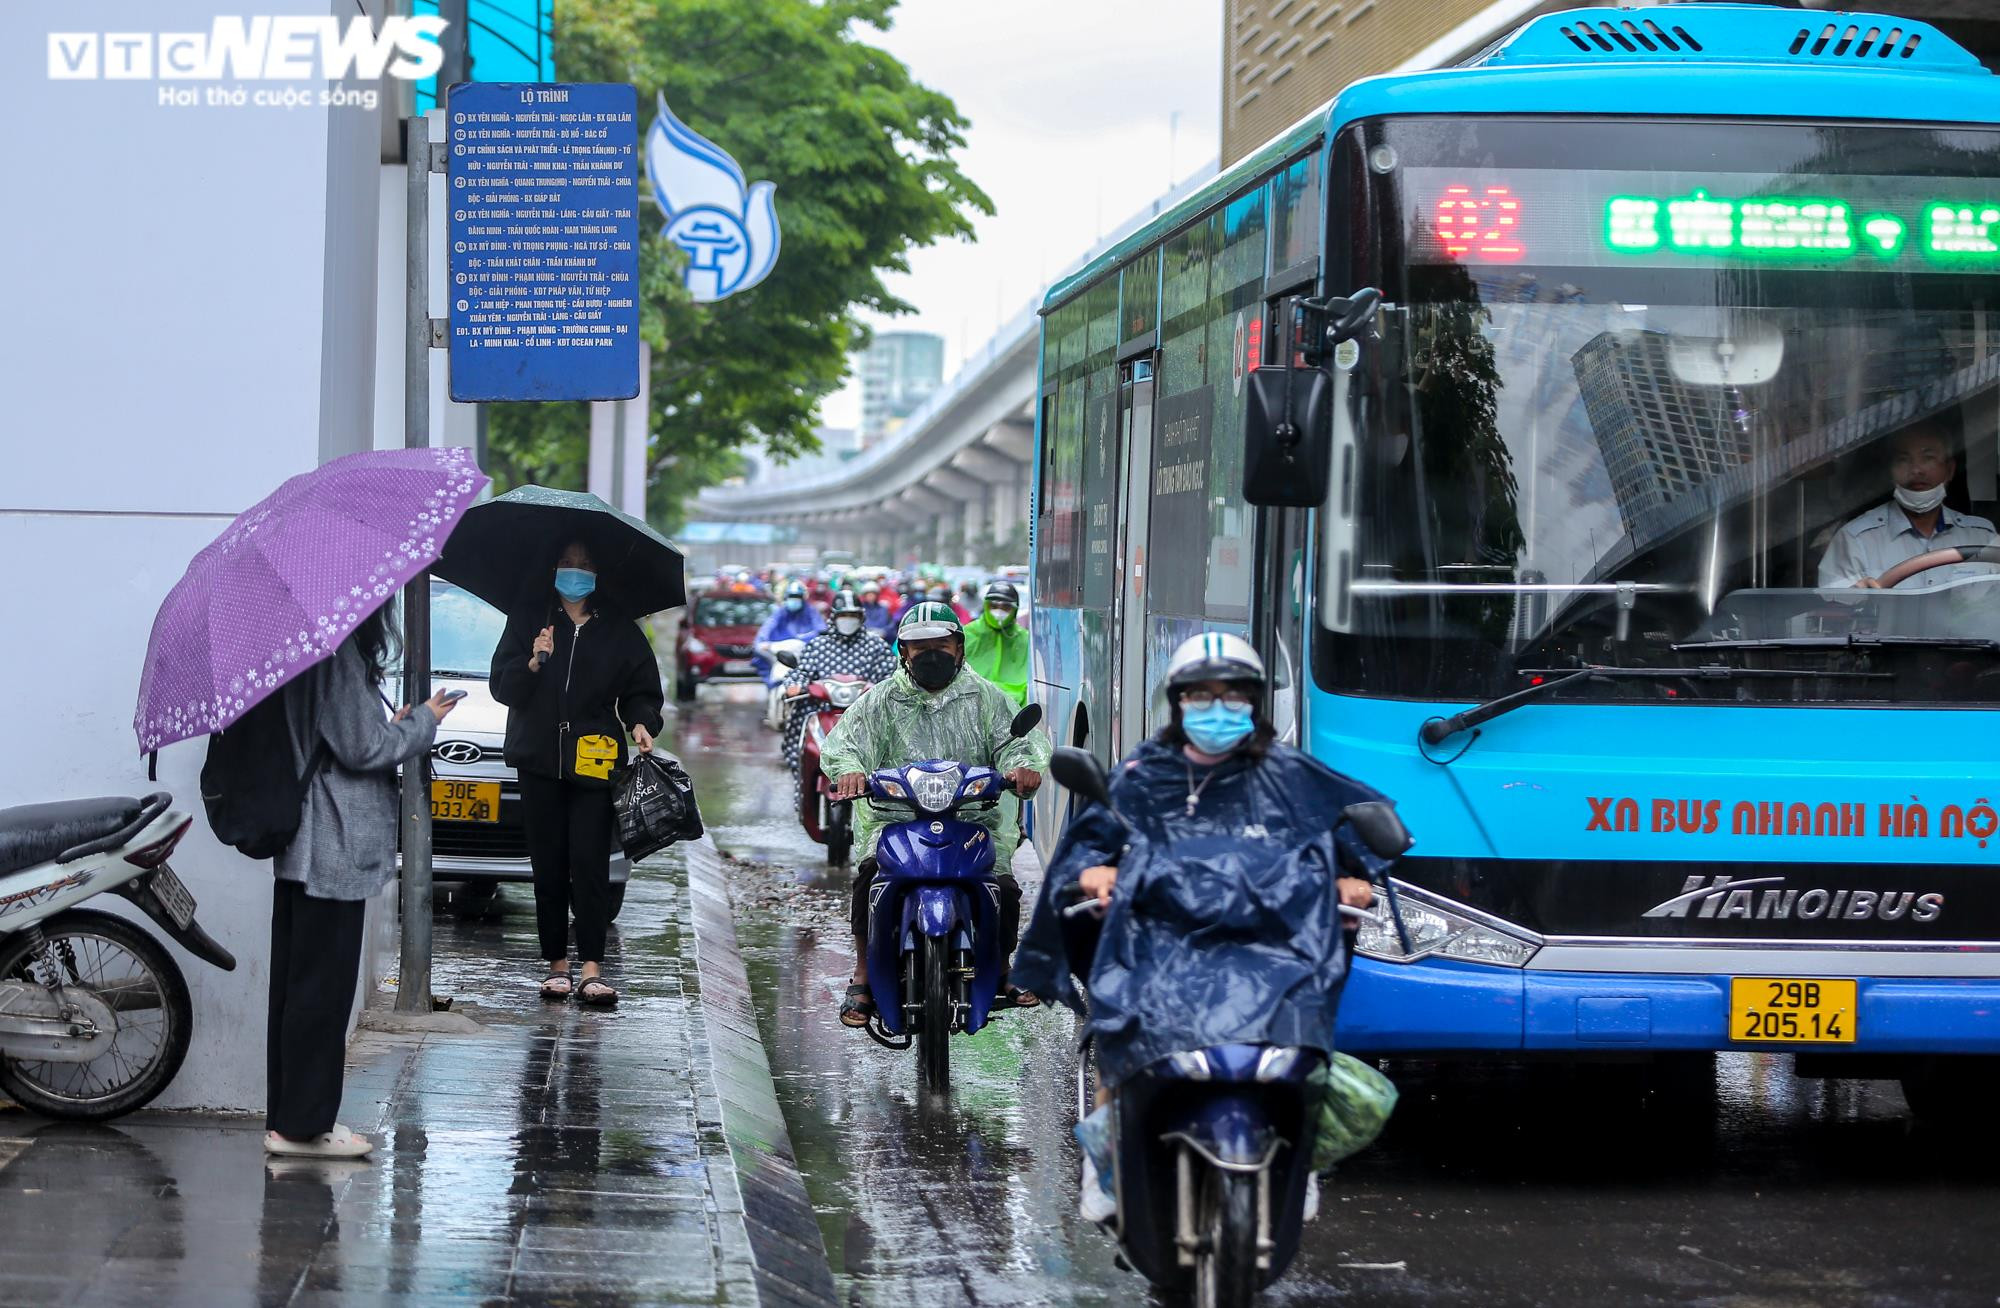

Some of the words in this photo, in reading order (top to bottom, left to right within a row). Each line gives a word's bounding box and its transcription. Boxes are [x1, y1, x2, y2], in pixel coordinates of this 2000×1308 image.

[521, 88, 534, 106] LỘ
[537, 88, 569, 103] TRÌNH
[468, 114, 476, 122] BX
[597, 114, 605, 122] BX
[607, 114, 617, 122] GIA
[468, 130, 477, 139] BX
[468, 146, 476, 154] HV
[534, 162, 551, 170] MINH
[552, 162, 567, 170] KHAI
[468, 178, 476, 187] BX
[514, 178, 535, 187] QUANG
[524, 194, 533, 203] BX
[468, 210, 476, 219] BX
[1437, 188, 1520, 253] 02
[486, 227, 502, 235] NINH
[564, 226, 579, 234] NAM
[601, 226, 618, 234] LONG
[468, 242, 478, 251] BX
[468, 273, 478, 282] BX
[481, 301, 494, 309] TAM
[515, 300, 533, 308] PHAN
[472, 327, 482, 335] BX
[484, 339, 502, 347] MINH
[503, 338, 520, 347] KHAI
[536, 338, 552, 347] LINH
[571, 338, 594, 347] OCEAN
[595, 338, 613, 347] PARK
[444, 782, 478, 800] 30E
[1586, 797, 1640, 832] XN
[1651, 798, 1721, 834] BUS
[1732, 801, 1866, 837] NHANH
[1878, 795, 1928, 838] HÀ
[1641, 875, 1945, 923] HANOIBUS
[1767, 982, 1821, 1009] 29B
[1744, 1012, 1842, 1039] 205.14
